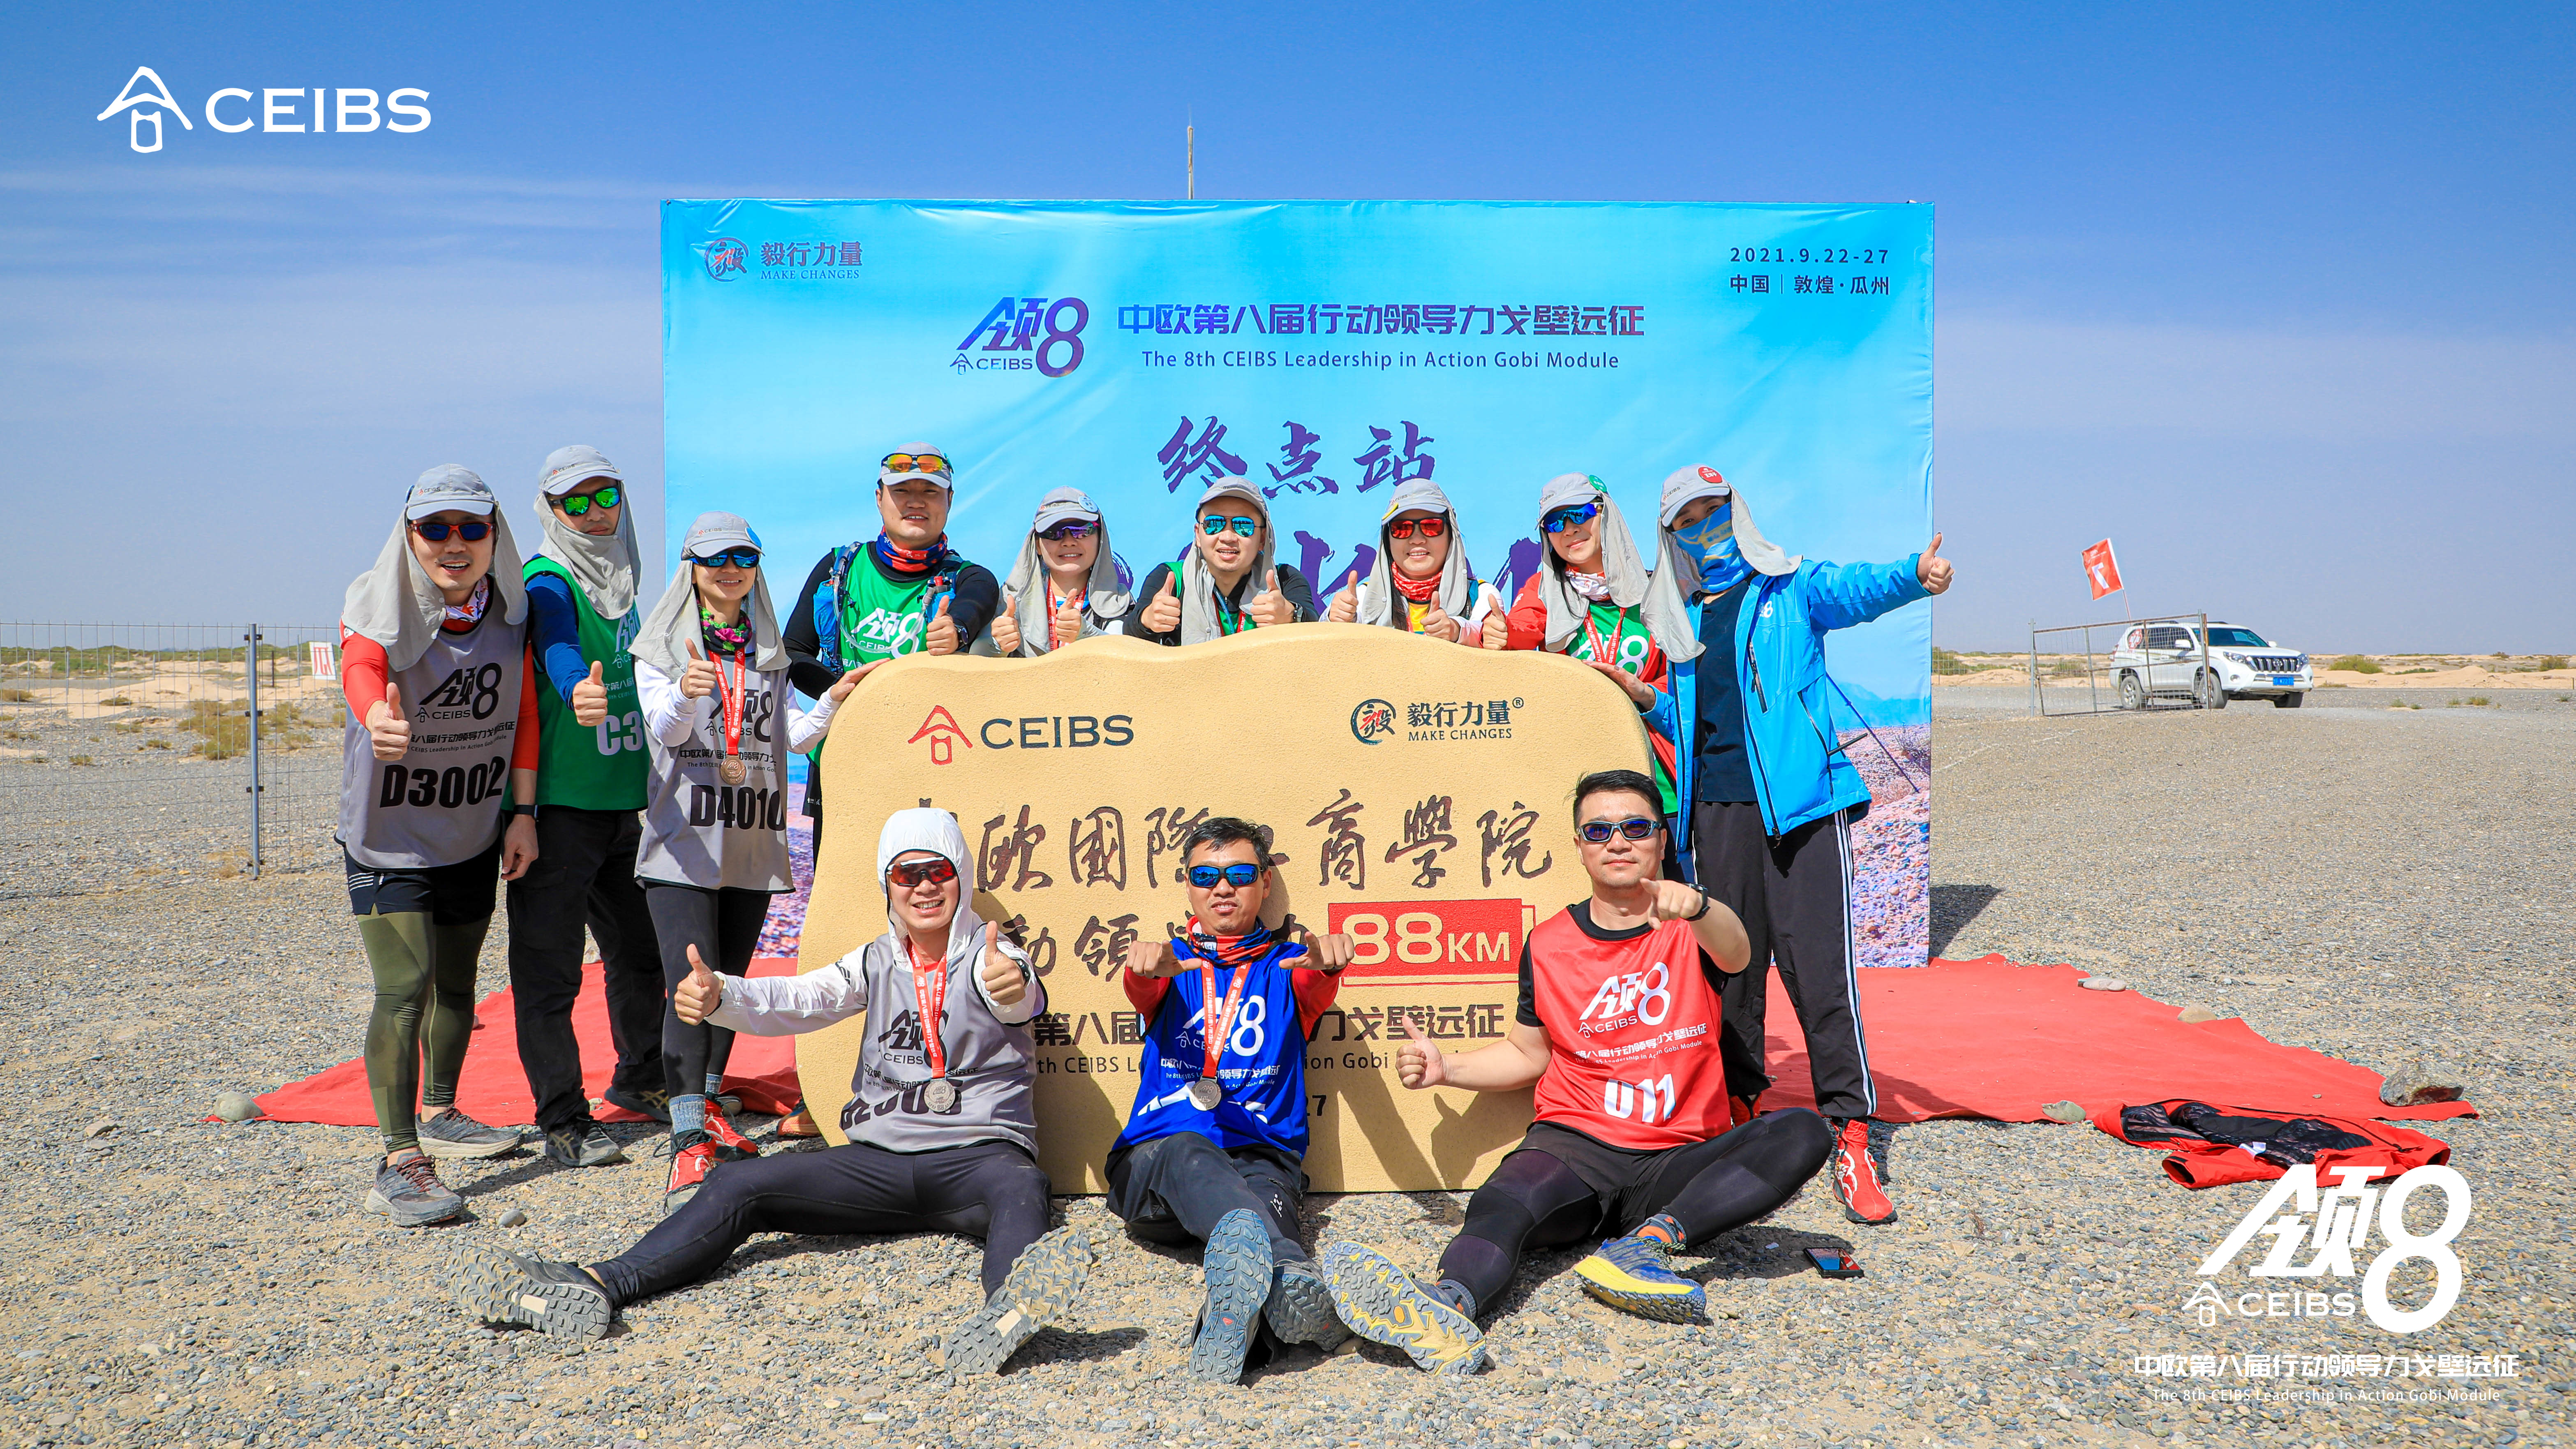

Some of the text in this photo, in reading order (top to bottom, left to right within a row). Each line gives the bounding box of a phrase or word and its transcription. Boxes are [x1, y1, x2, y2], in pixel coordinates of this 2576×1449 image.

[760, 241, 863, 266] 毅行力量
[1730, 247, 1889, 264] 2021.9.22-27
[761, 270, 859, 279] MAKE CHANGES
[1118, 304, 1645, 336] 中欧第八届行动领导力戈壁远征
[976, 358, 1033, 370] CEIBS
[1142, 351, 1619, 371] The 8th CEIBS Leadership in Action Gobi Module
[432, 709, 471, 719] CEIBS
[1407, 700, 1511, 728] 毅行力量
[719, 727, 752, 736] CBS
[981, 715, 1134, 749] CEIBS
[1408, 728, 1512, 741] MAKE CHANGES
[379, 756, 506, 808] D3002
[1594, 1015, 1638, 1033] CEIBS
[1680, 1040, 1702, 1049] Module
[883, 1053, 923, 1065] CEIBS
[1037, 1057, 1056, 1074] th
[1065, 1056, 1119, 1074] CEIBS
[1304, 1054, 1334, 1070] ion
[1342, 1052, 1389, 1069] Gobi
